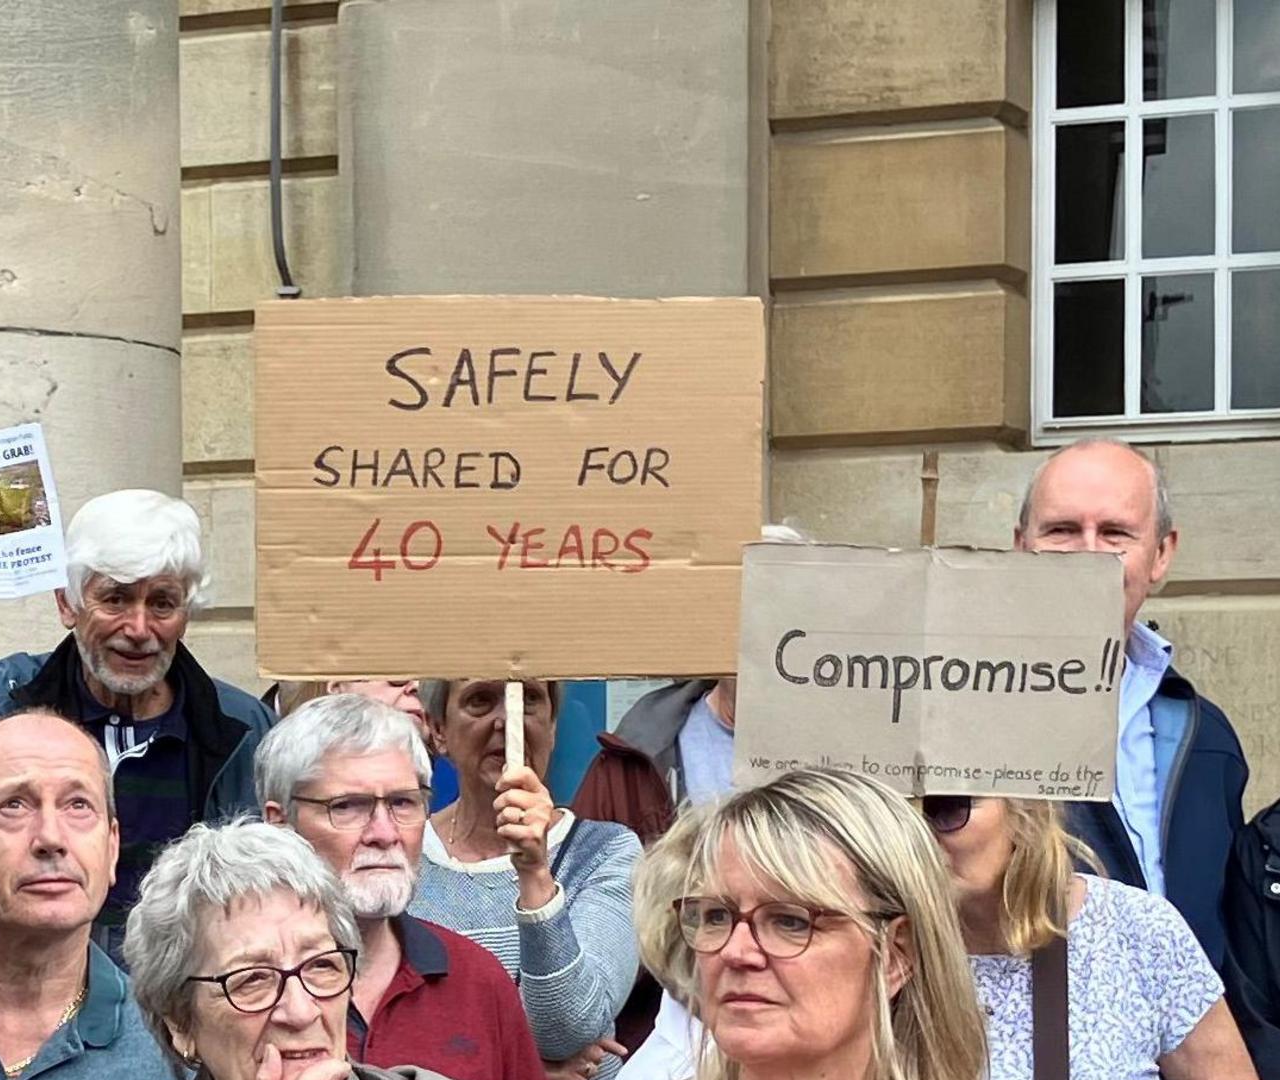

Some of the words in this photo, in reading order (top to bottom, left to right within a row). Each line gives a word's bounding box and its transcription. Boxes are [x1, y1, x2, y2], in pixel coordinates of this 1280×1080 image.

[385, 347, 642, 411] SAFELY
[313, 445, 521, 490] SHARED
[577, 447, 670, 488] FOR
[348, 518, 443, 581] 40
[486, 521, 654, 573] YEARS
[862, 755, 880, 775] to
[1049, 762, 1069, 782] do
[1076, 763, 1104, 786] the
